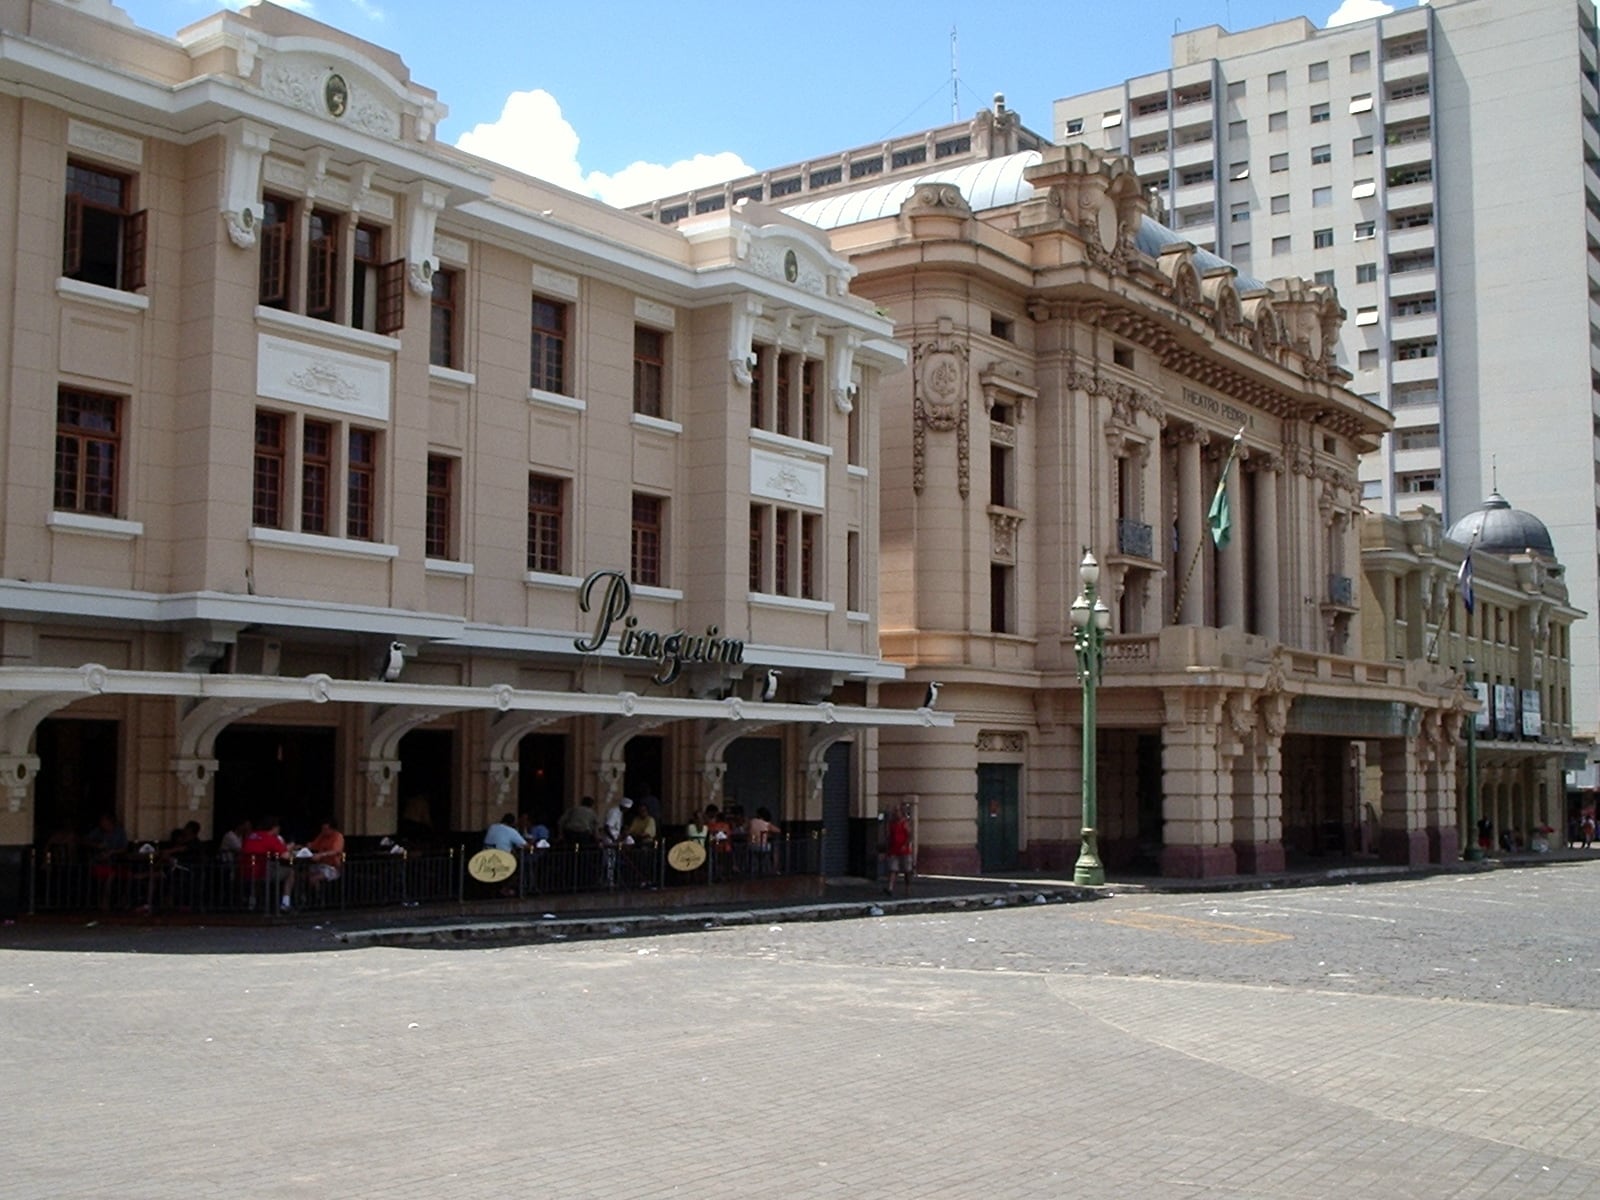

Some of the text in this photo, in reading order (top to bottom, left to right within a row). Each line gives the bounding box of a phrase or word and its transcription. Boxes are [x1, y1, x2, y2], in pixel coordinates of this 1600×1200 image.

[1182, 386, 1219, 413] THEATRO
[1221, 403, 1247, 425] PEDRO
[574, 570, 744, 685] Pinguim
